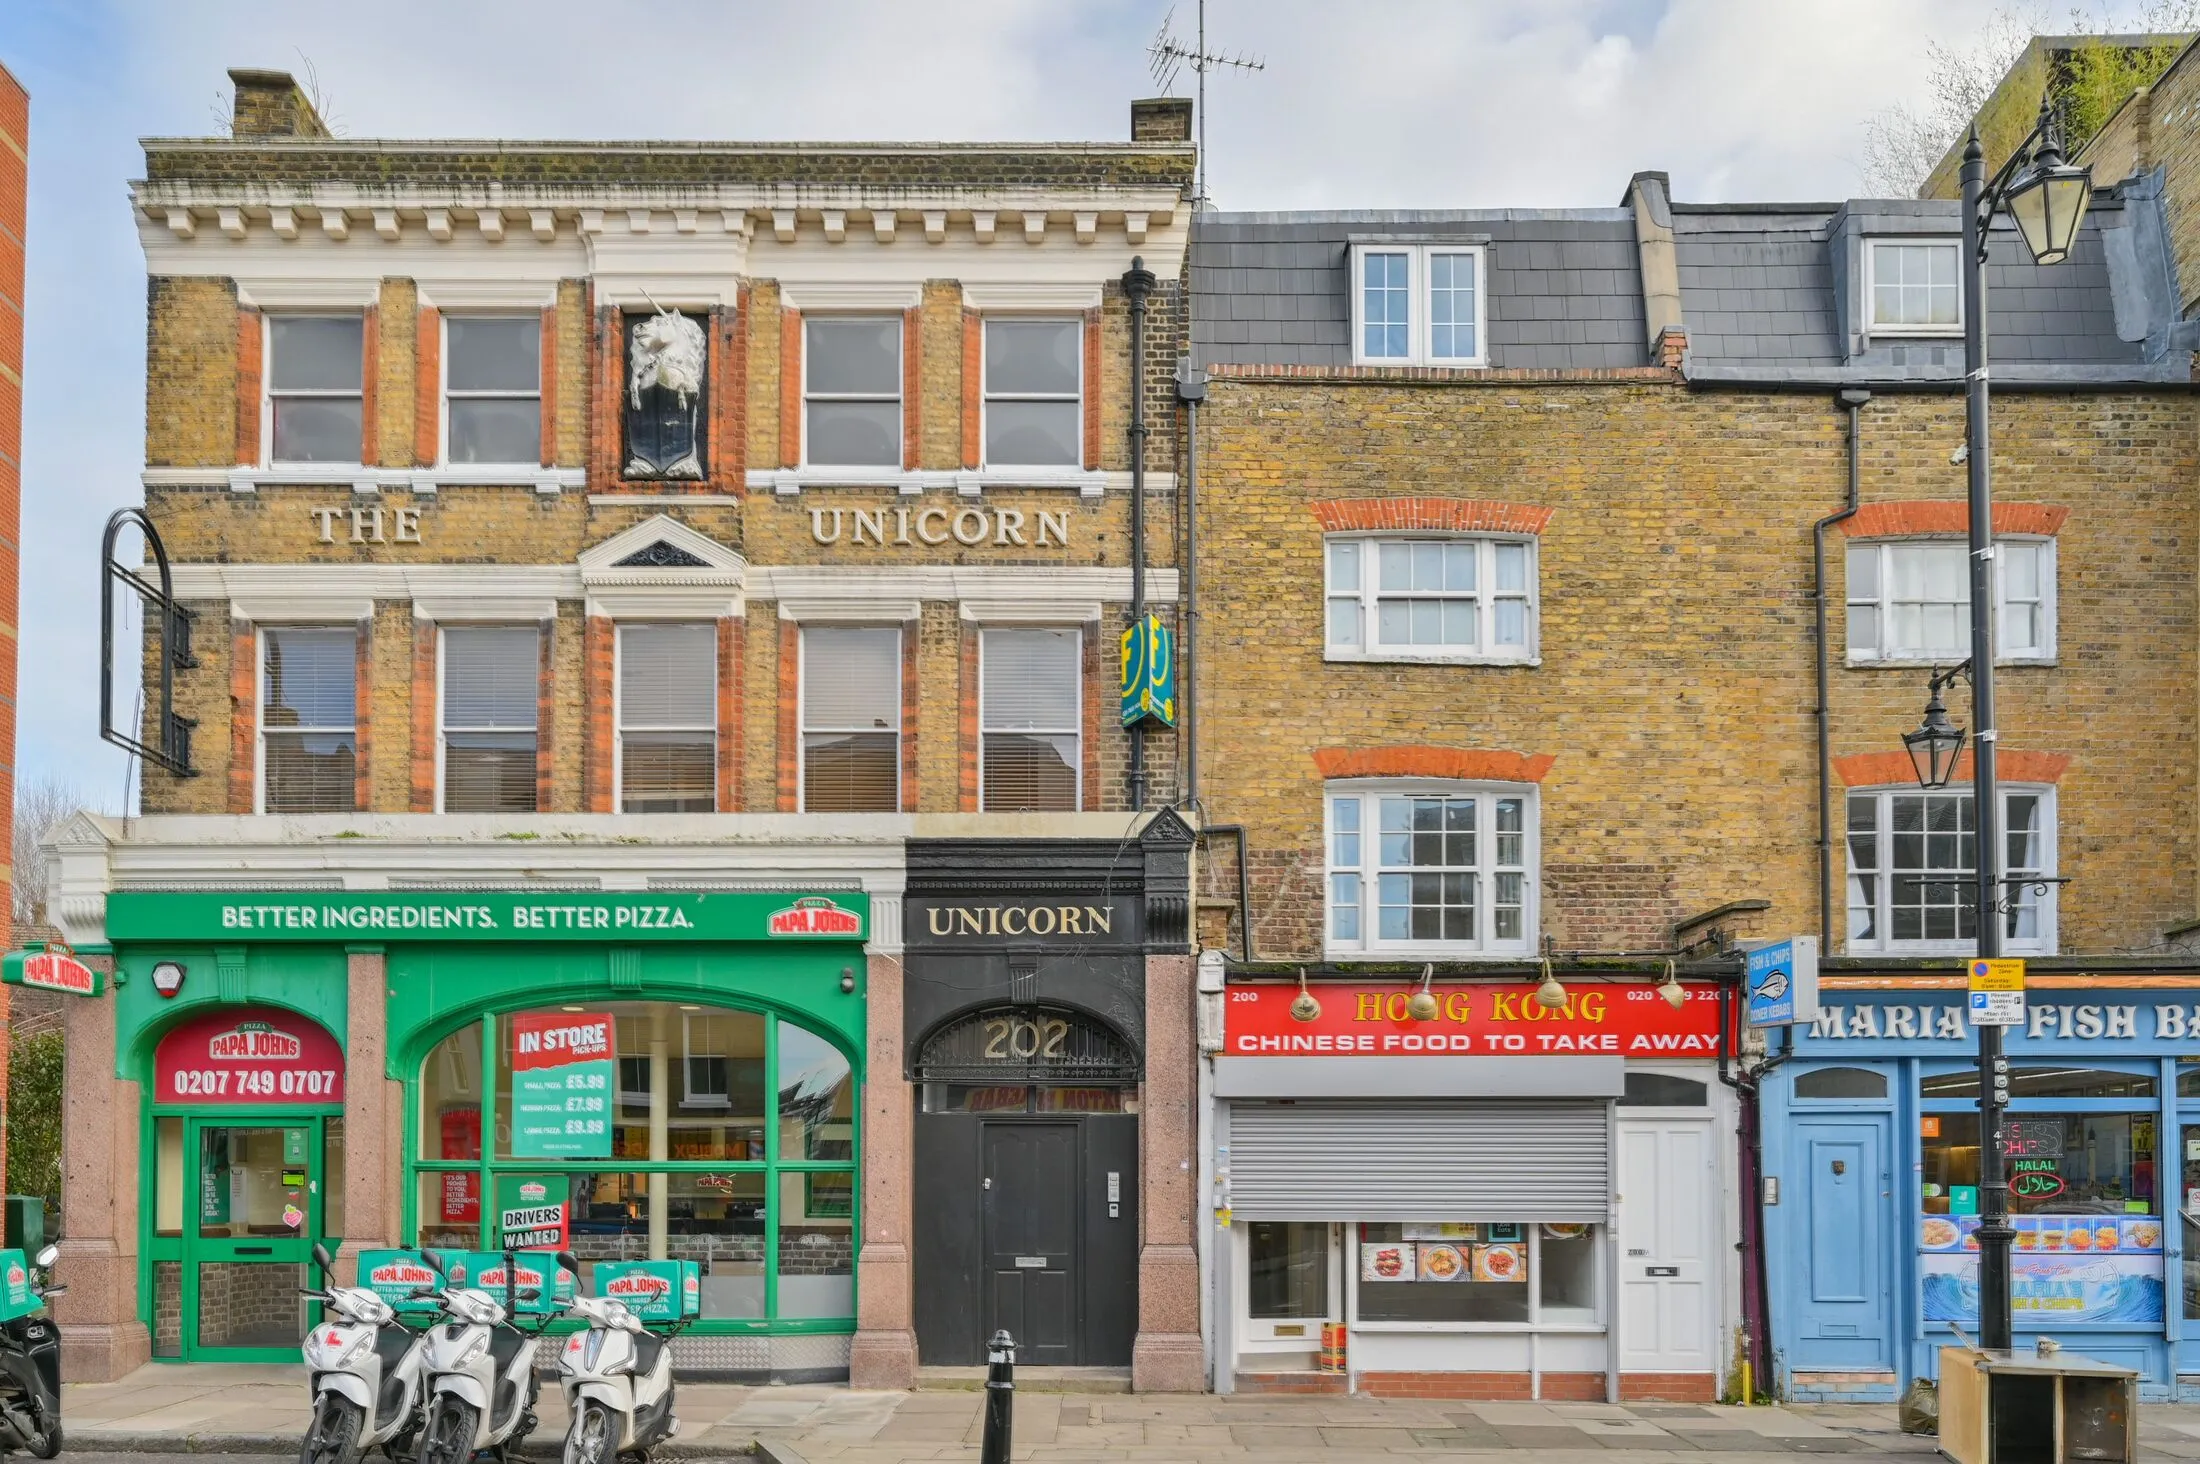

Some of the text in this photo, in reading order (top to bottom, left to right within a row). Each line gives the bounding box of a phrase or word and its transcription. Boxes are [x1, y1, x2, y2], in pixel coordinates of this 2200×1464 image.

[310, 507, 421, 544] THE
[808, 507, 1070, 546] UNICORN
[221, 906, 498, 928] BETTER INGREDIENTS.
[513, 906, 694, 928] BETTER PIZZA.
[772, 911, 809, 932] PAPA
[926, 906, 1114, 935] UNICORN
[1749, 956, 1764, 971] FISH
[1771, 947, 1790, 964] CHIPS
[25, 955, 54, 983] PAPA
[1232, 992, 1258, 1002] 200
[1627, 991, 1652, 1000] 020
[1768, 1002, 1791, 1017] KEBABS
[2027, 1005, 2137, 1039] FISH
[213, 1033, 297, 1056] PAPA JOHNS
[519, 1023, 607, 1053] IN STORE
[984, 1019, 1070, 1058] 202
[1237, 1034, 1721, 1051] CHINESE FOOD TO TAKE AWAY
[572, 1043, 607, 1055] PICK-UPS
[174, 1070, 336, 1094] 0207 749 0707
[566, 1074, 606, 1089] £5.99
[566, 1096, 603, 1112] £7.99
[1993, 1131, 2002, 1139] 4
[1995, 1141, 2000, 1149] 1
[2015, 1160, 2056, 1171] HALAL
[2018, 1175, 2058, 1194] حلال
[505, 1207, 560, 1227] DRIVERS
[504, 1229, 559, 1248] WANTED
[373, 1267, 397, 1281] PAPA
[480, 1268, 505, 1284] PAPA
[608, 1279, 633, 1293] PAPA
